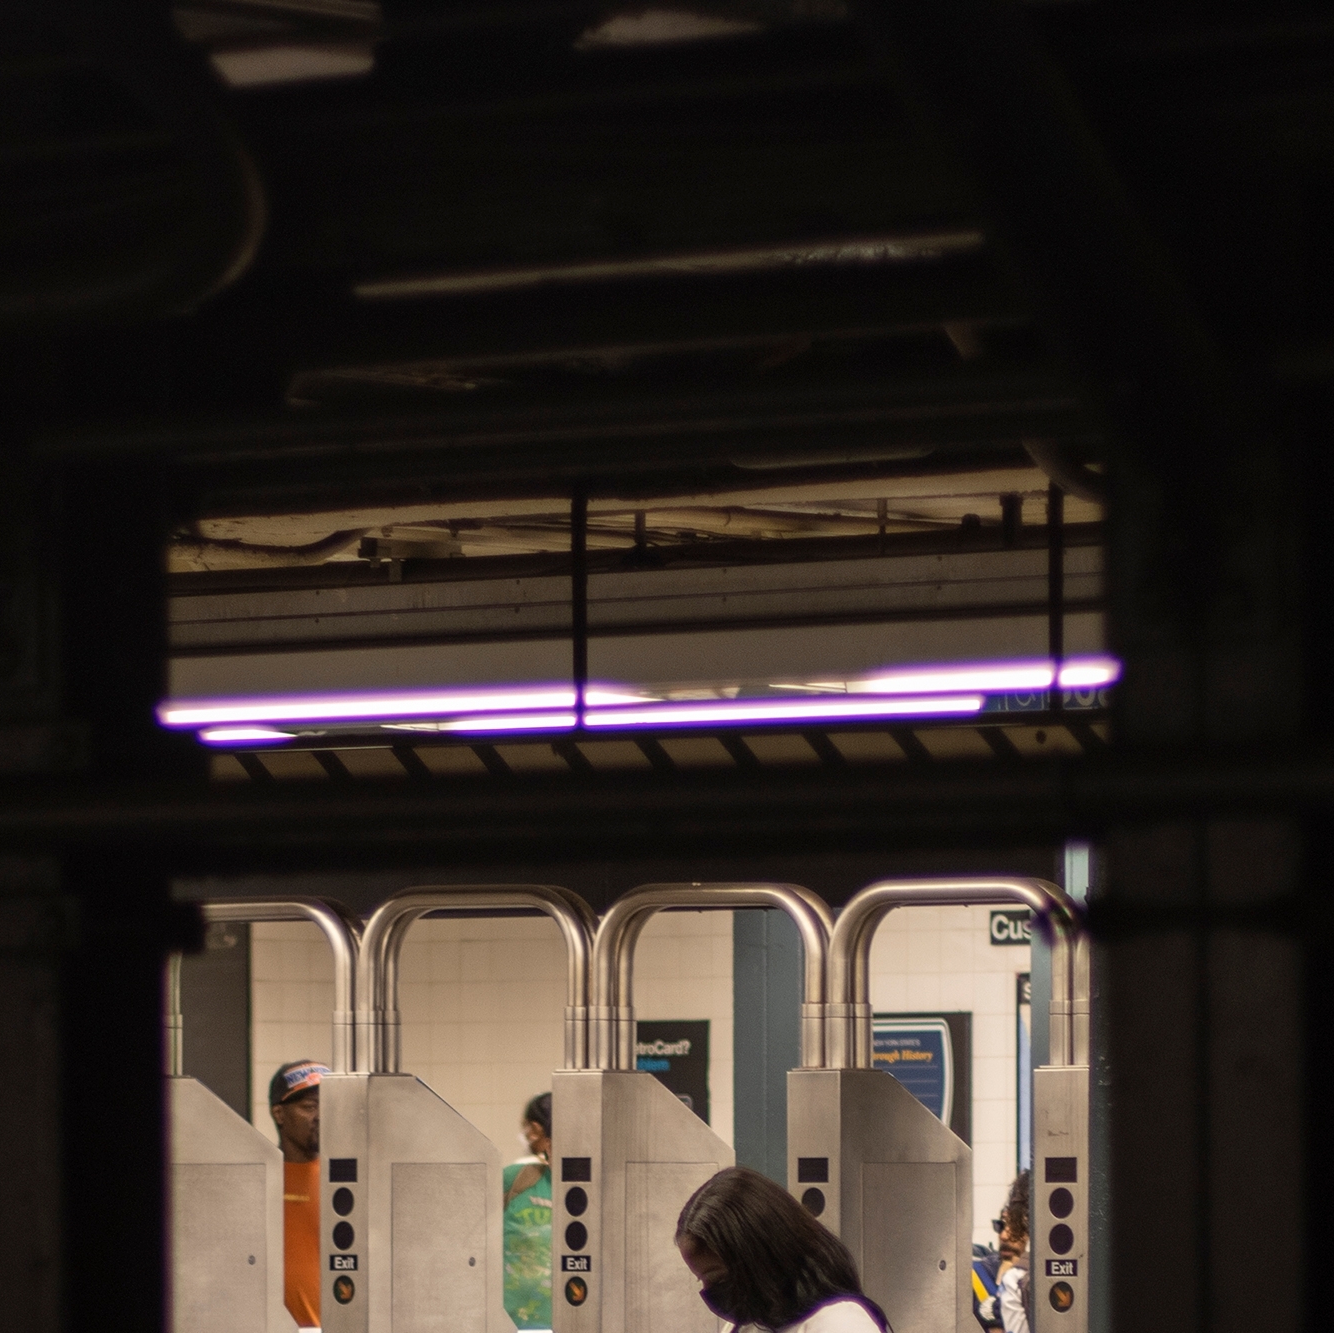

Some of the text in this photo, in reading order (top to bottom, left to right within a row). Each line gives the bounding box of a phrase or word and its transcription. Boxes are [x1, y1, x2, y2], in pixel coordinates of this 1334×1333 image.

[334, 1257, 354, 1269] Exit
[567, 1257, 587, 1270] Exit
[1051, 1261, 1073, 1275] Exit
